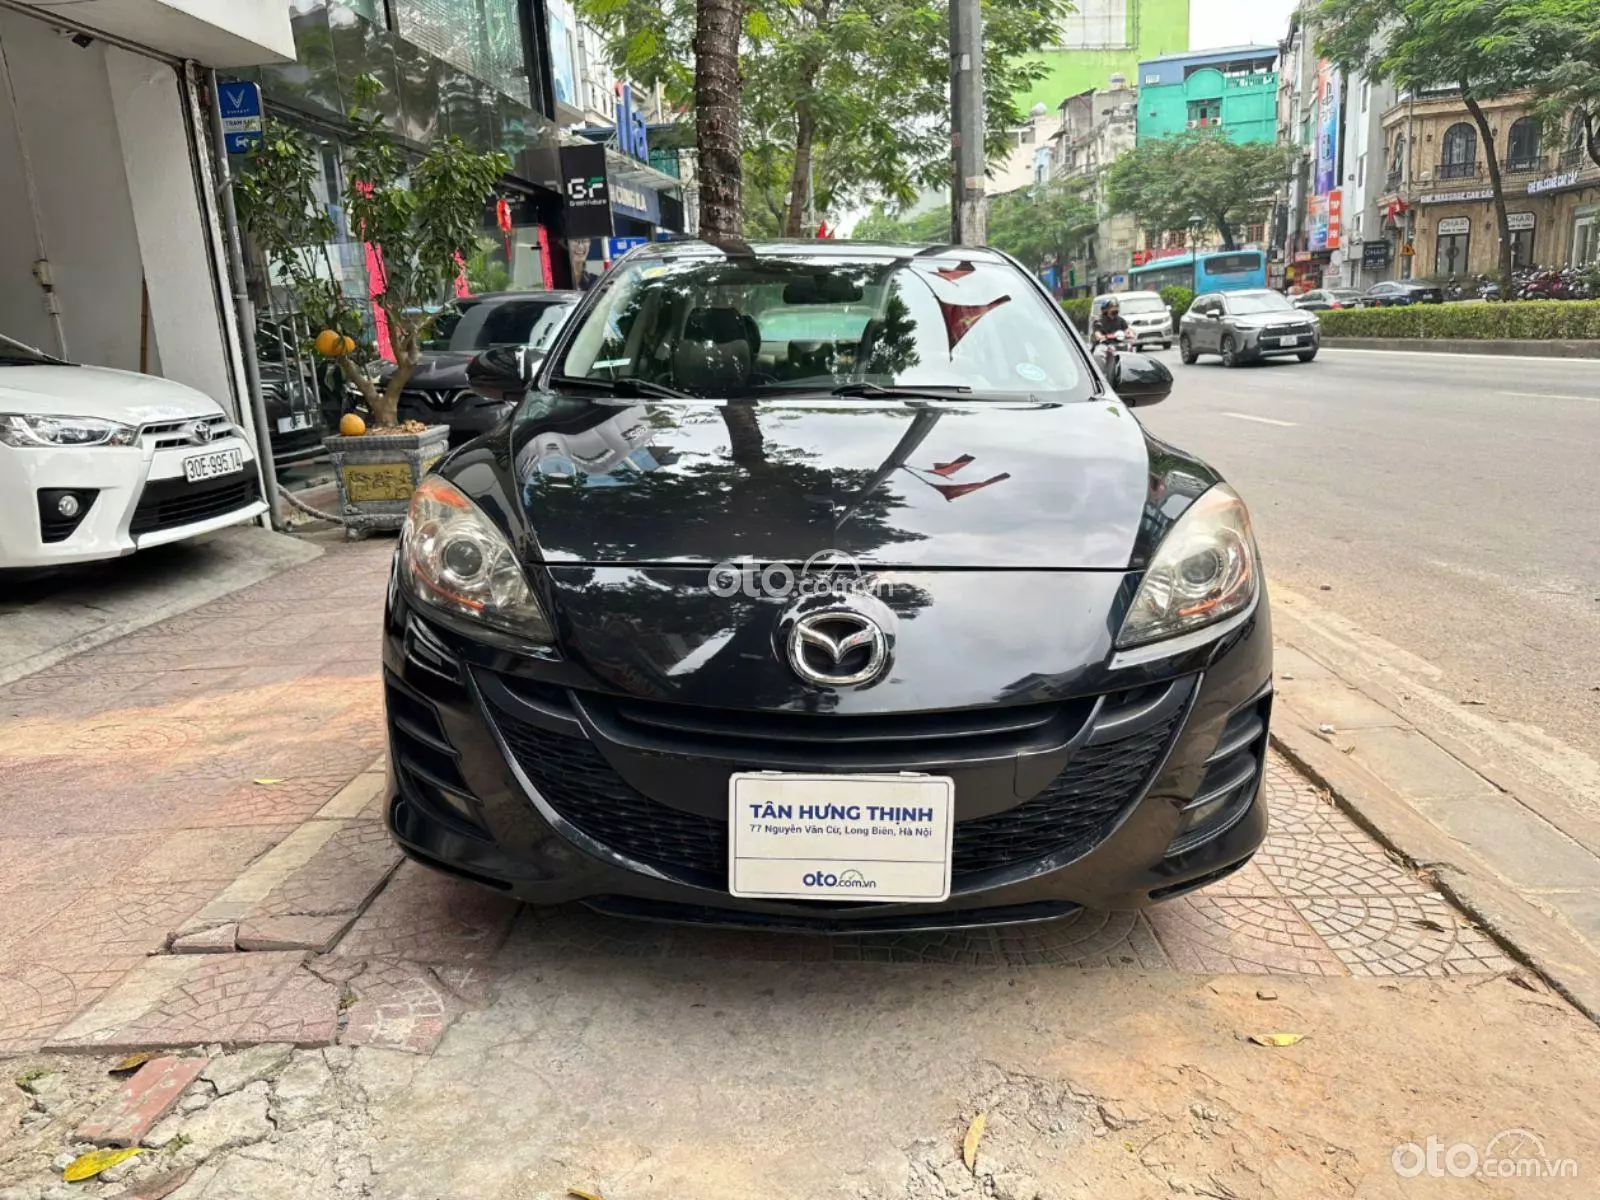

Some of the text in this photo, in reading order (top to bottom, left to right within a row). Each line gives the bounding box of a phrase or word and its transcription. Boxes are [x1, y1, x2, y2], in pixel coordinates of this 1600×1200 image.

[566, 176, 605, 199] GF
[186, 450, 241, 479] 30E-995.14
[749, 800, 933, 825] TÂN HƯNG THỊNH
[749, 824, 762, 833] 77
[845, 826, 869, 836] Long
[899, 827, 913, 836] Hà
[915, 827, 932, 837] Nội
[803, 871, 877, 888] oto.com.vn
